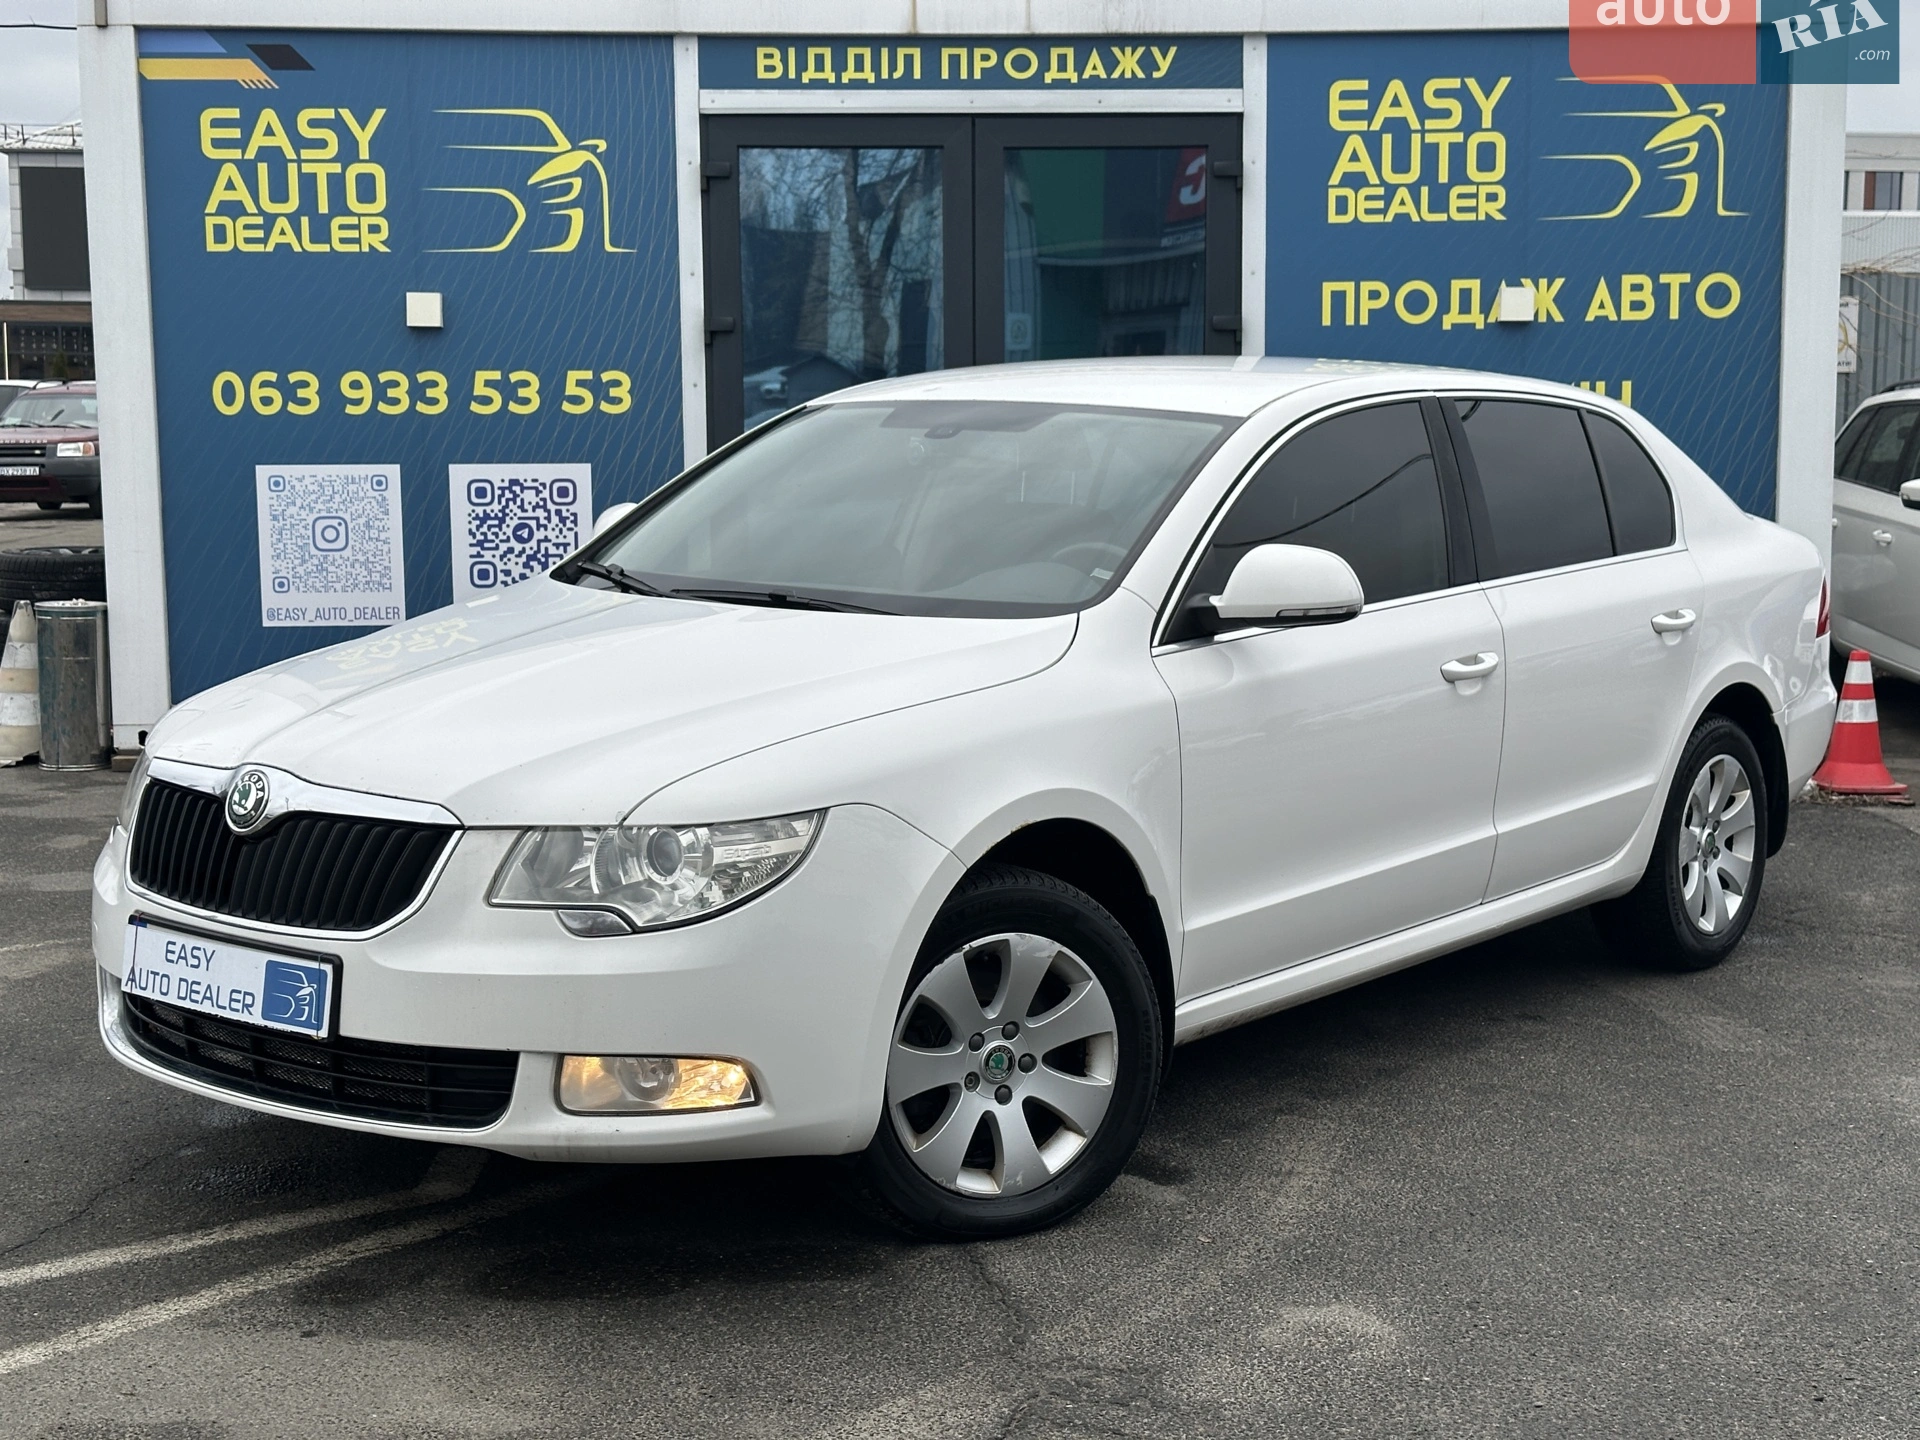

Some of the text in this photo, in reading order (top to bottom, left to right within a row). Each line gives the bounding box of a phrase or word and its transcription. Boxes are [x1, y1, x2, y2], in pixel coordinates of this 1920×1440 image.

[756, 46, 1178, 83] ВІДДІЛ ПРОДАЖУ
[1328, 76, 1511, 132] EASY
[200, 107, 387, 160] EASY
[1328, 132, 1507, 186] AUTO
[204, 162, 387, 214] AUTO
[1327, 185, 1507, 224] DEALER
[205, 215, 391, 253] DEALER
[1585, 272, 1741, 322] АВТО
[212, 370, 632, 416] 063 933 53 53
[266, 606, 401, 623] @EASY_AUTO_DEALER
[164, 940, 217, 972] EASY
[124, 965, 256, 1016] AUTO DEALER
